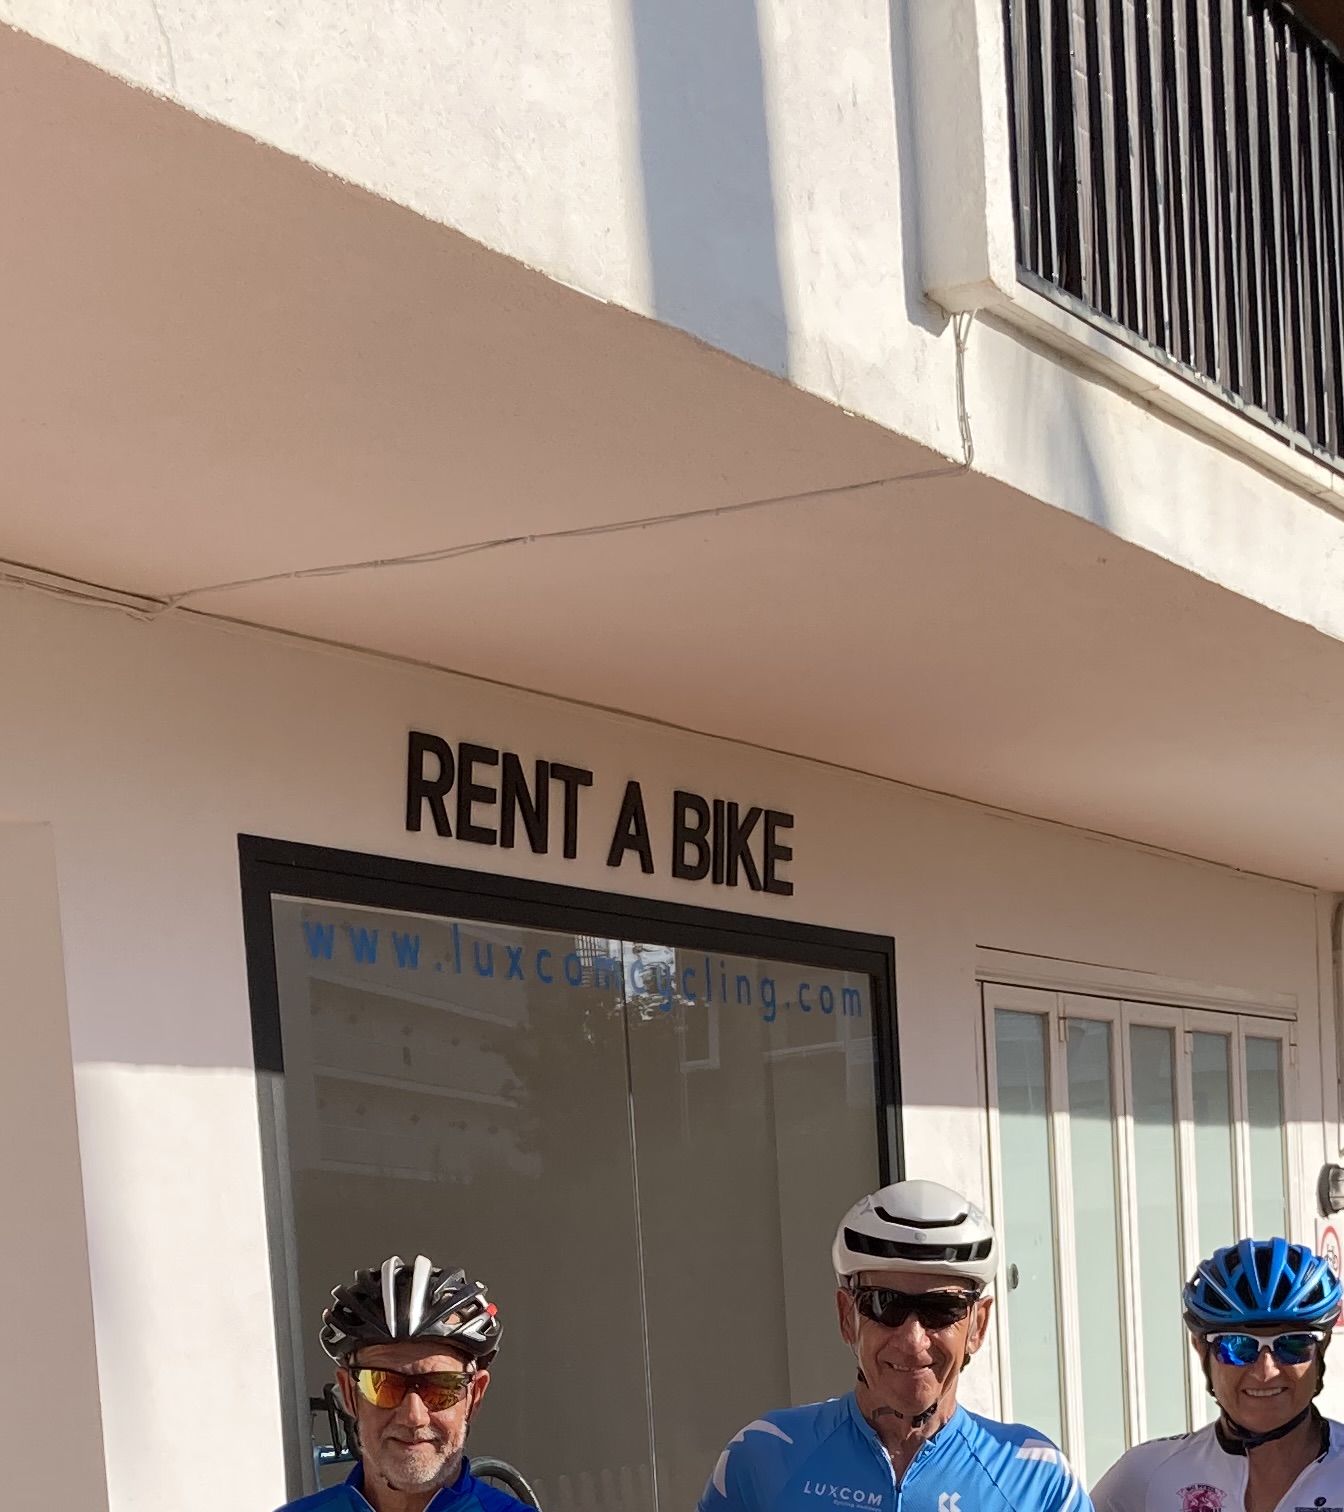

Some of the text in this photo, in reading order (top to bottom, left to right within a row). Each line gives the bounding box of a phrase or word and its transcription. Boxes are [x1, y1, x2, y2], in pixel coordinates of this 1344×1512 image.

[406, 730, 795, 897] RENT A BIKE
[302, 919, 863, 1023] www.luxcomcycling.com
[803, 1480, 883, 1507] LUXCOM
